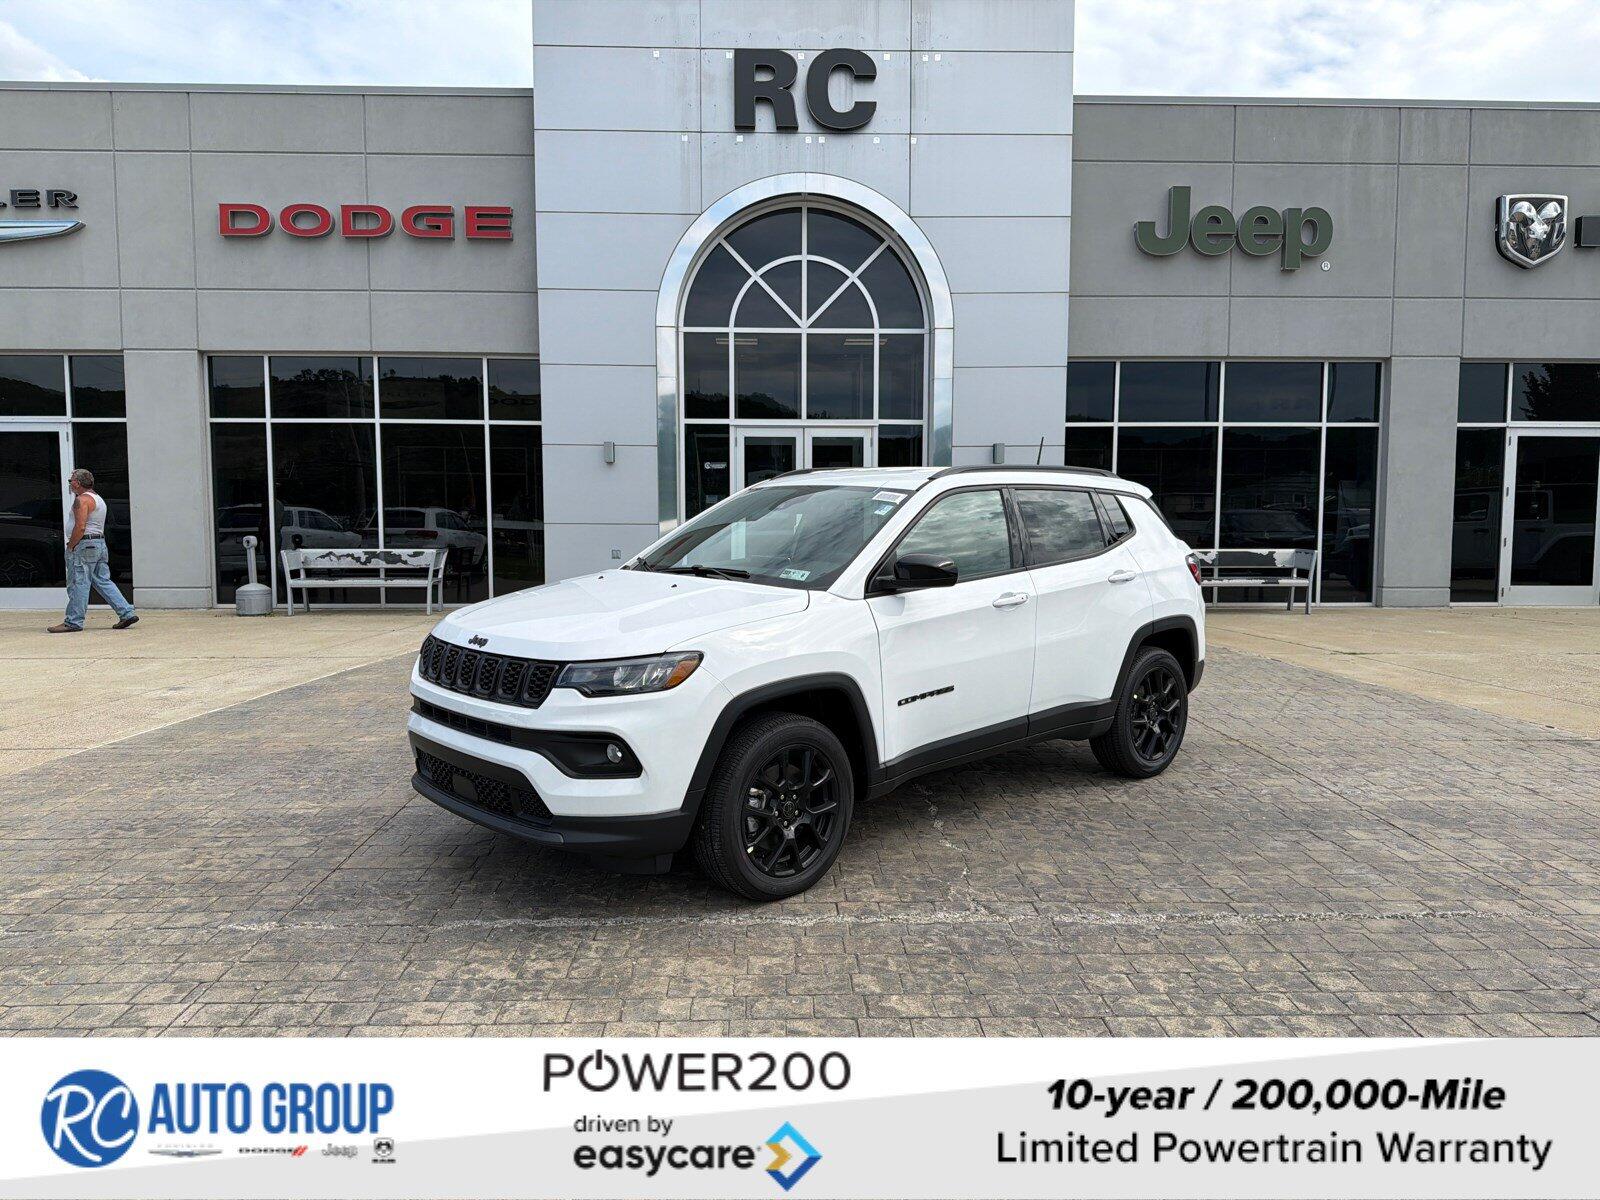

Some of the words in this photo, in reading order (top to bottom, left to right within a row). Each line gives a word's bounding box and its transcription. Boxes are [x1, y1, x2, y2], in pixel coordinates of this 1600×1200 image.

[733, 48, 877, 131] RC
[0, 188, 79, 208] ER
[218, 203, 513, 240] DODGE
[1134, 185, 1334, 271] Jeep
